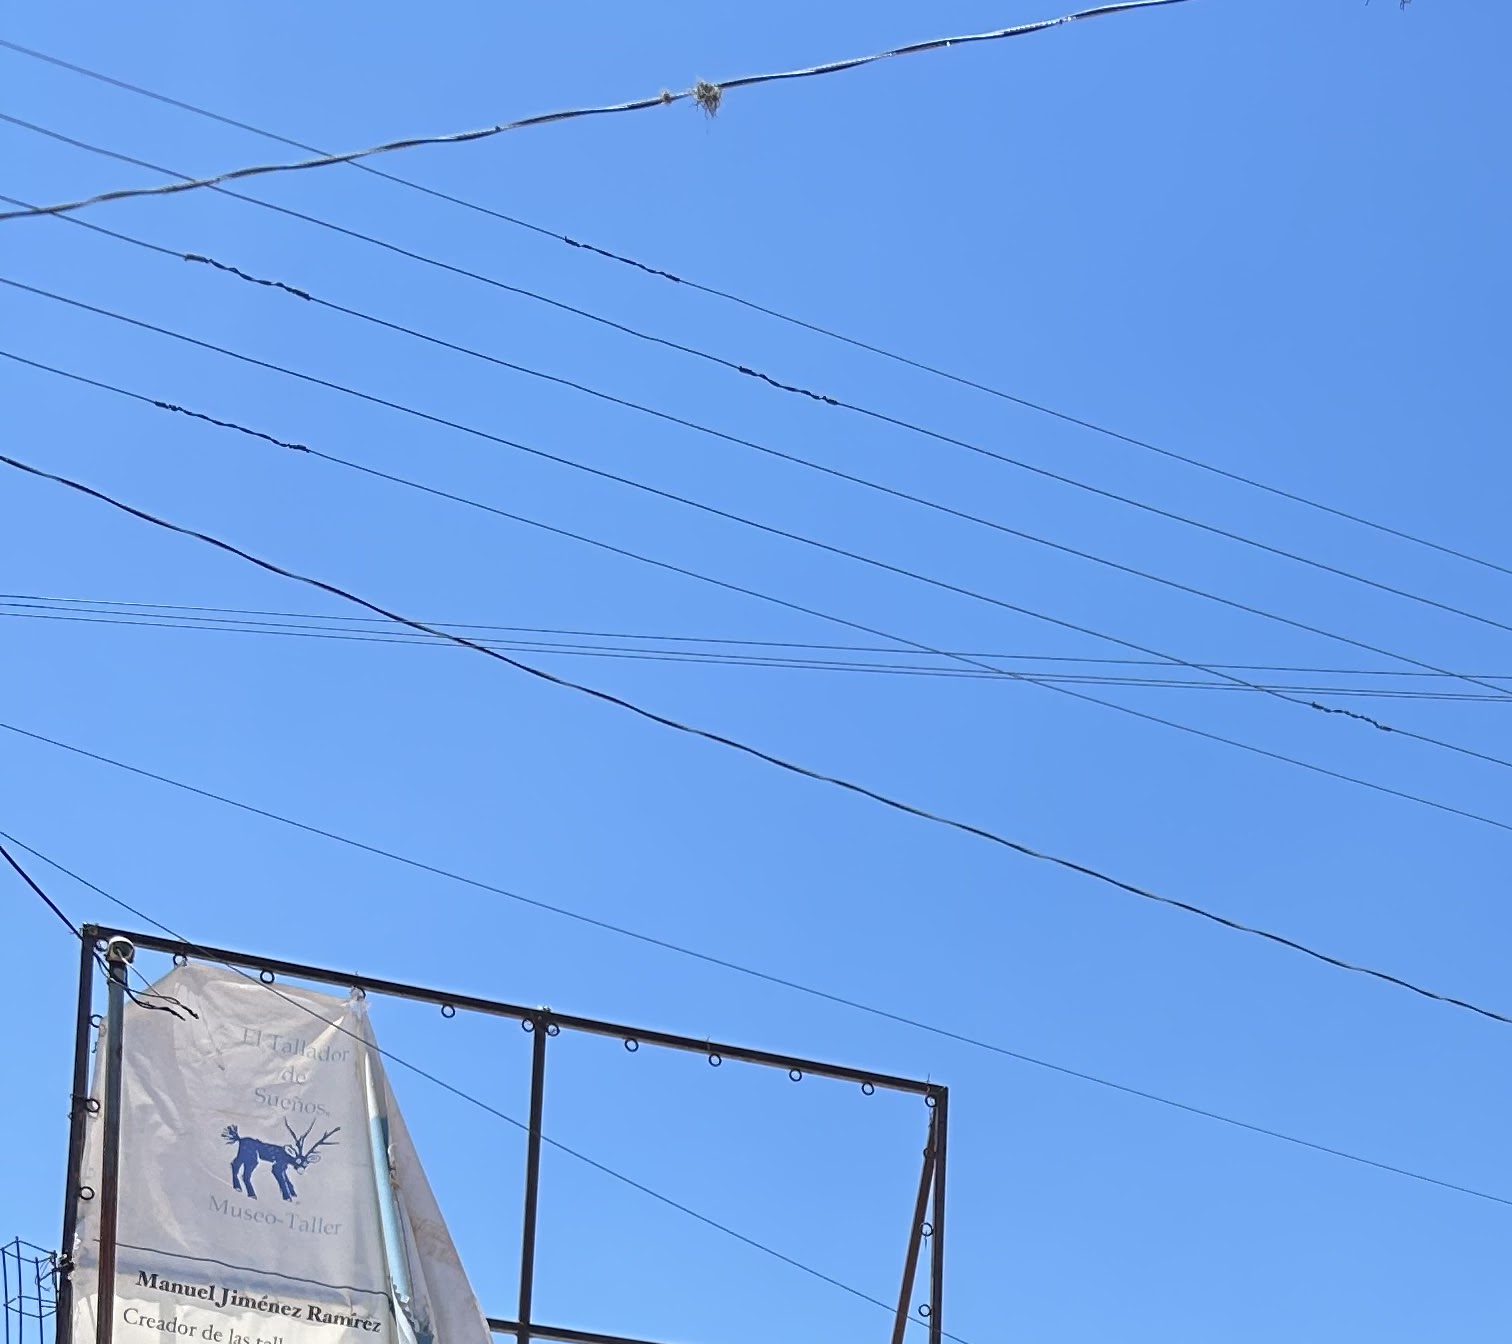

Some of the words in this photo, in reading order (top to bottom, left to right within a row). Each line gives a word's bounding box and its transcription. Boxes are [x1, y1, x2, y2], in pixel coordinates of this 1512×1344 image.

[243, 1027, 261, 1046] El
[267, 1034, 350, 1062] Tallador
[281, 1065, 307, 1084] de
[208, 1195, 343, 1236] Museo-Taller
[135, 1270, 215, 1301] Manuel
[215, 1287, 302, 1319] Jiménez
[306, 1304, 381, 1333] Ramírez
[123, 1307, 197, 1338] Creador
[201, 1324, 223, 1343] de
